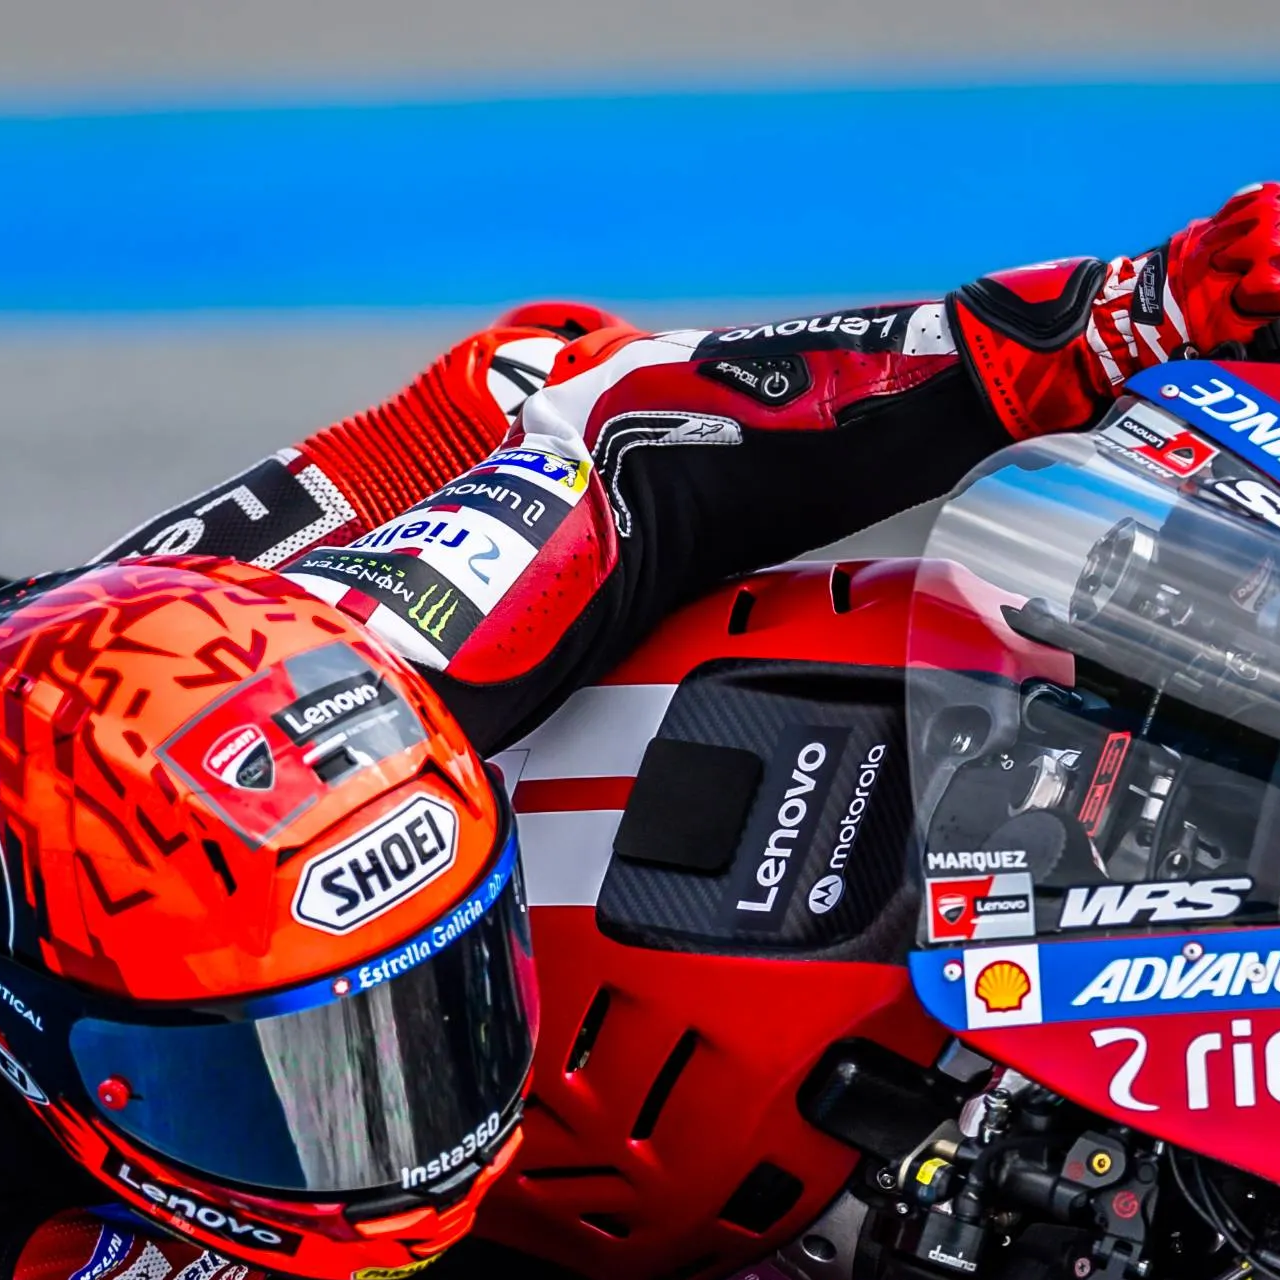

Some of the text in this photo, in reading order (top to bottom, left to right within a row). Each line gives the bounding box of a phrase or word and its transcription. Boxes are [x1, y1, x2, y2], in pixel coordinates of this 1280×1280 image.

[718, 313, 898, 343] Lenovo
[1123, 420, 1166, 449] Lenovo
[349, 520, 471, 549] riello
[302, 559, 415, 603] MONSTER
[284, 683, 379, 735] Lenovo
[210, 728, 257, 769] DUCATI
[736, 742, 827, 913] Lenovo
[830, 744, 887, 869] motorola
[321, 809, 445, 918] SHOEI
[927, 850, 1029, 872] MARQUEZ
[975, 899, 1027, 913] Lenovo
[1059, 877, 1253, 928] WRS
[358, 899, 484, 989] Estrella Galicia
[401, 1112, 501, 1190] Insta360
[118, 1163, 283, 1246] Lenovo
